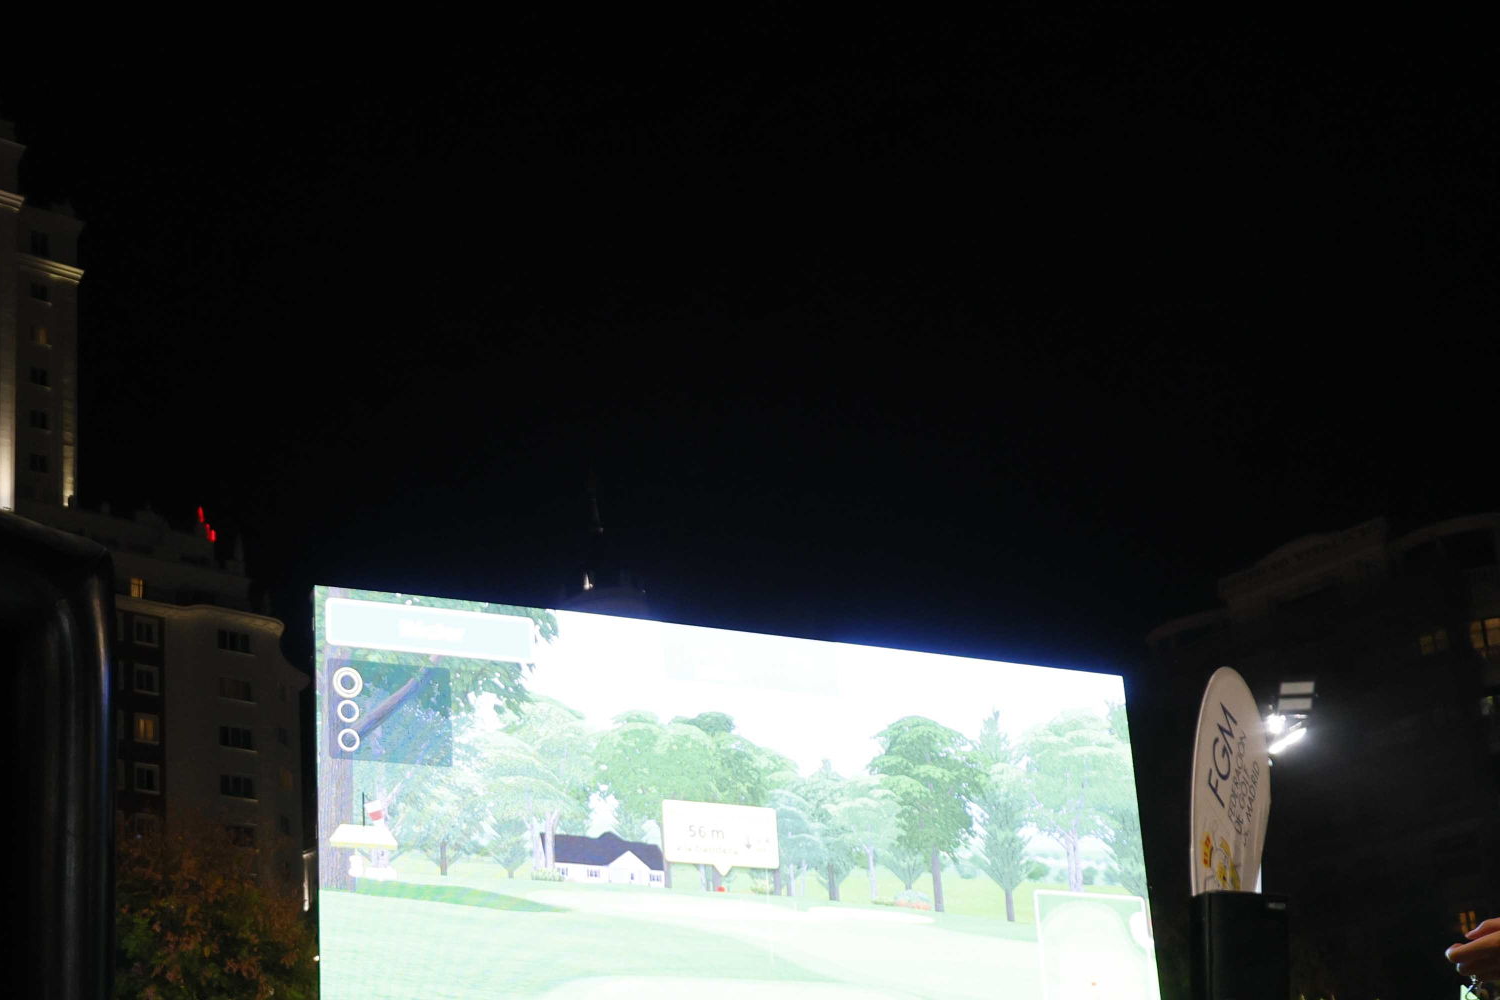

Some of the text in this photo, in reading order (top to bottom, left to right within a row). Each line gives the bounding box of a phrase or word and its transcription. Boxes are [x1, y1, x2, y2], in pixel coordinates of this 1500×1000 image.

[1208, 701, 1238, 809] FGM
[1245, 760, 1261, 823] MADRID
[688, 824, 725, 839] 56 m
[1233, 813, 1244, 835] DE
